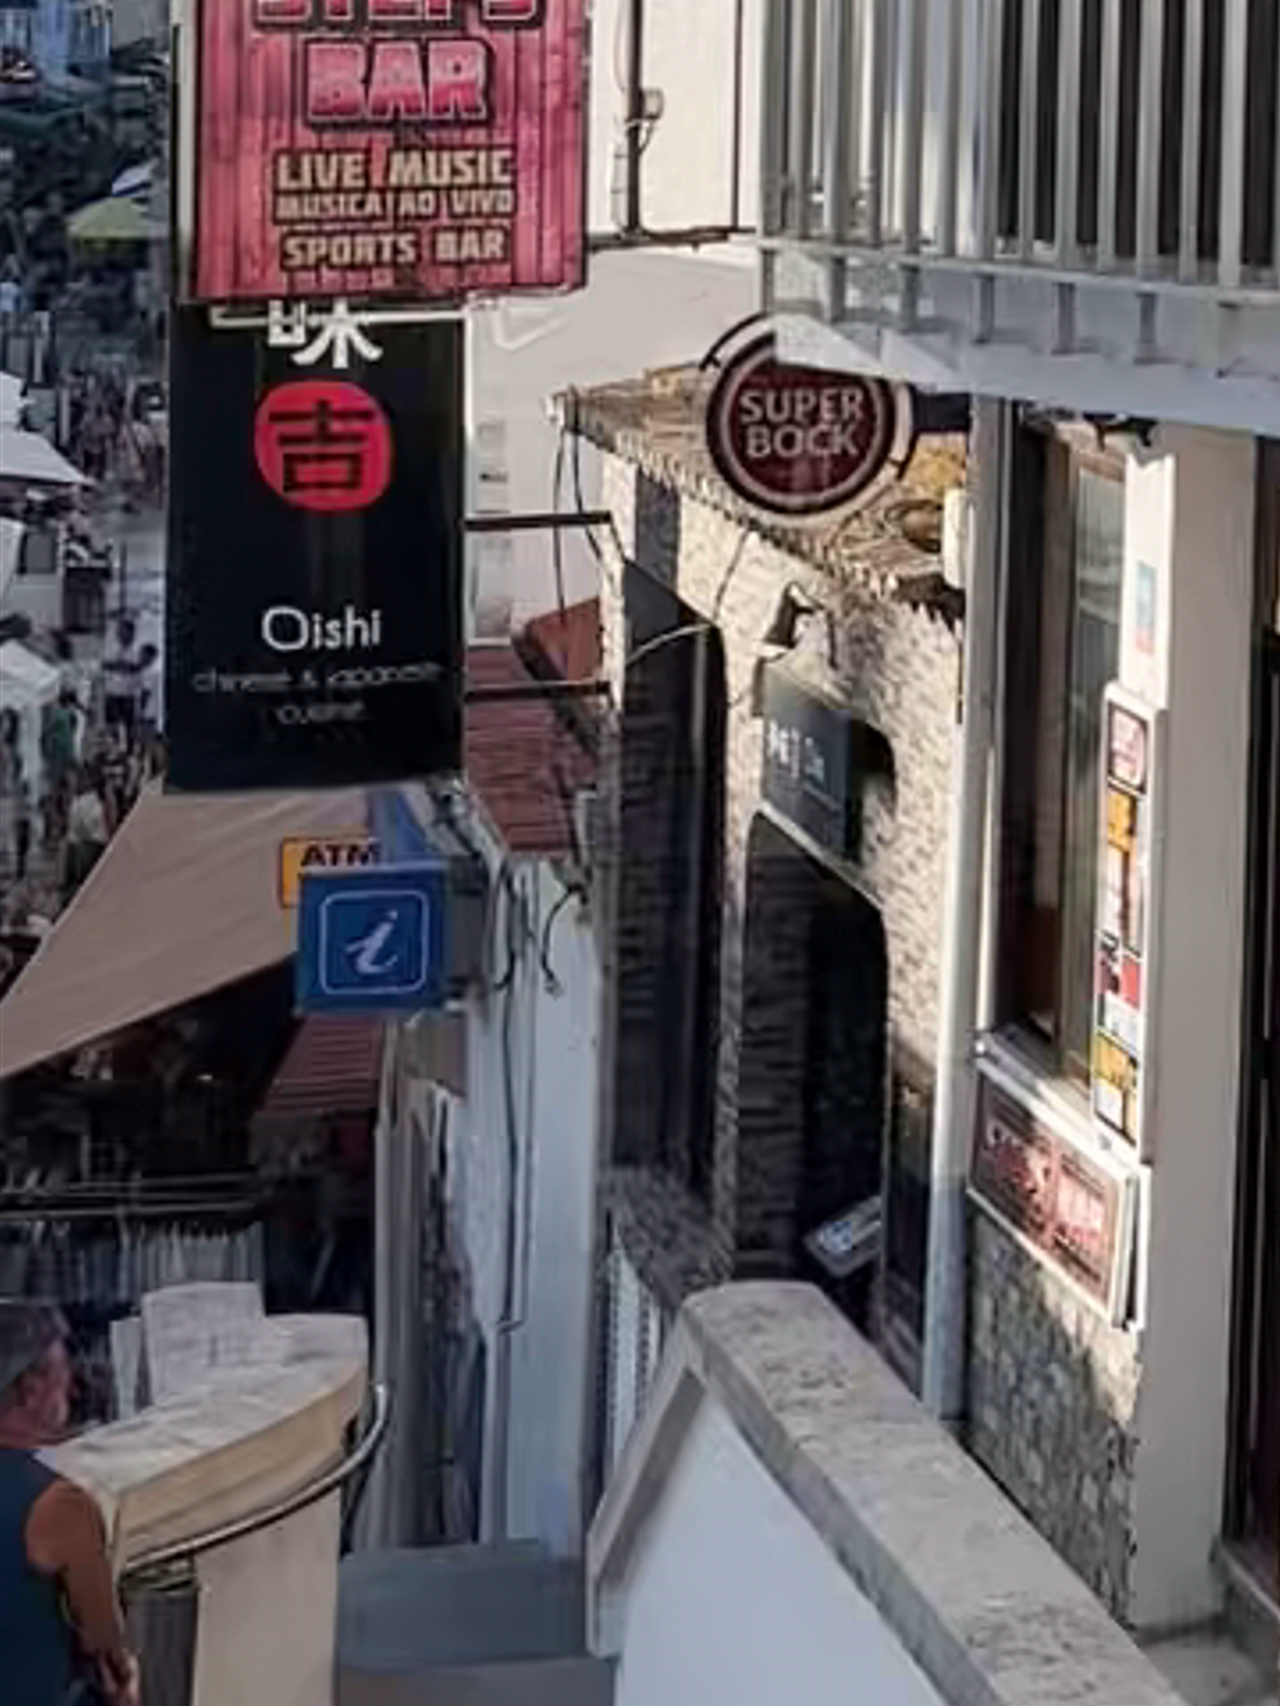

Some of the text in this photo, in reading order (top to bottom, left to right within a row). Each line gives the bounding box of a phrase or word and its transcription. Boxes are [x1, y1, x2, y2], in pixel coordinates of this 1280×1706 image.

[307, 41, 487, 122] BAR
[278, 150, 514, 190] LIVE MUSIC
[400, 190, 435, 215] AO
[450, 189, 514, 214] VIVO
[283, 229, 505, 266] SPORTS BAR
[740, 389, 864, 424] SUPER
[746, 423, 859, 460] BOCK
[260, 604, 384, 653] Oishi
[301, 842, 380, 868] ATM
